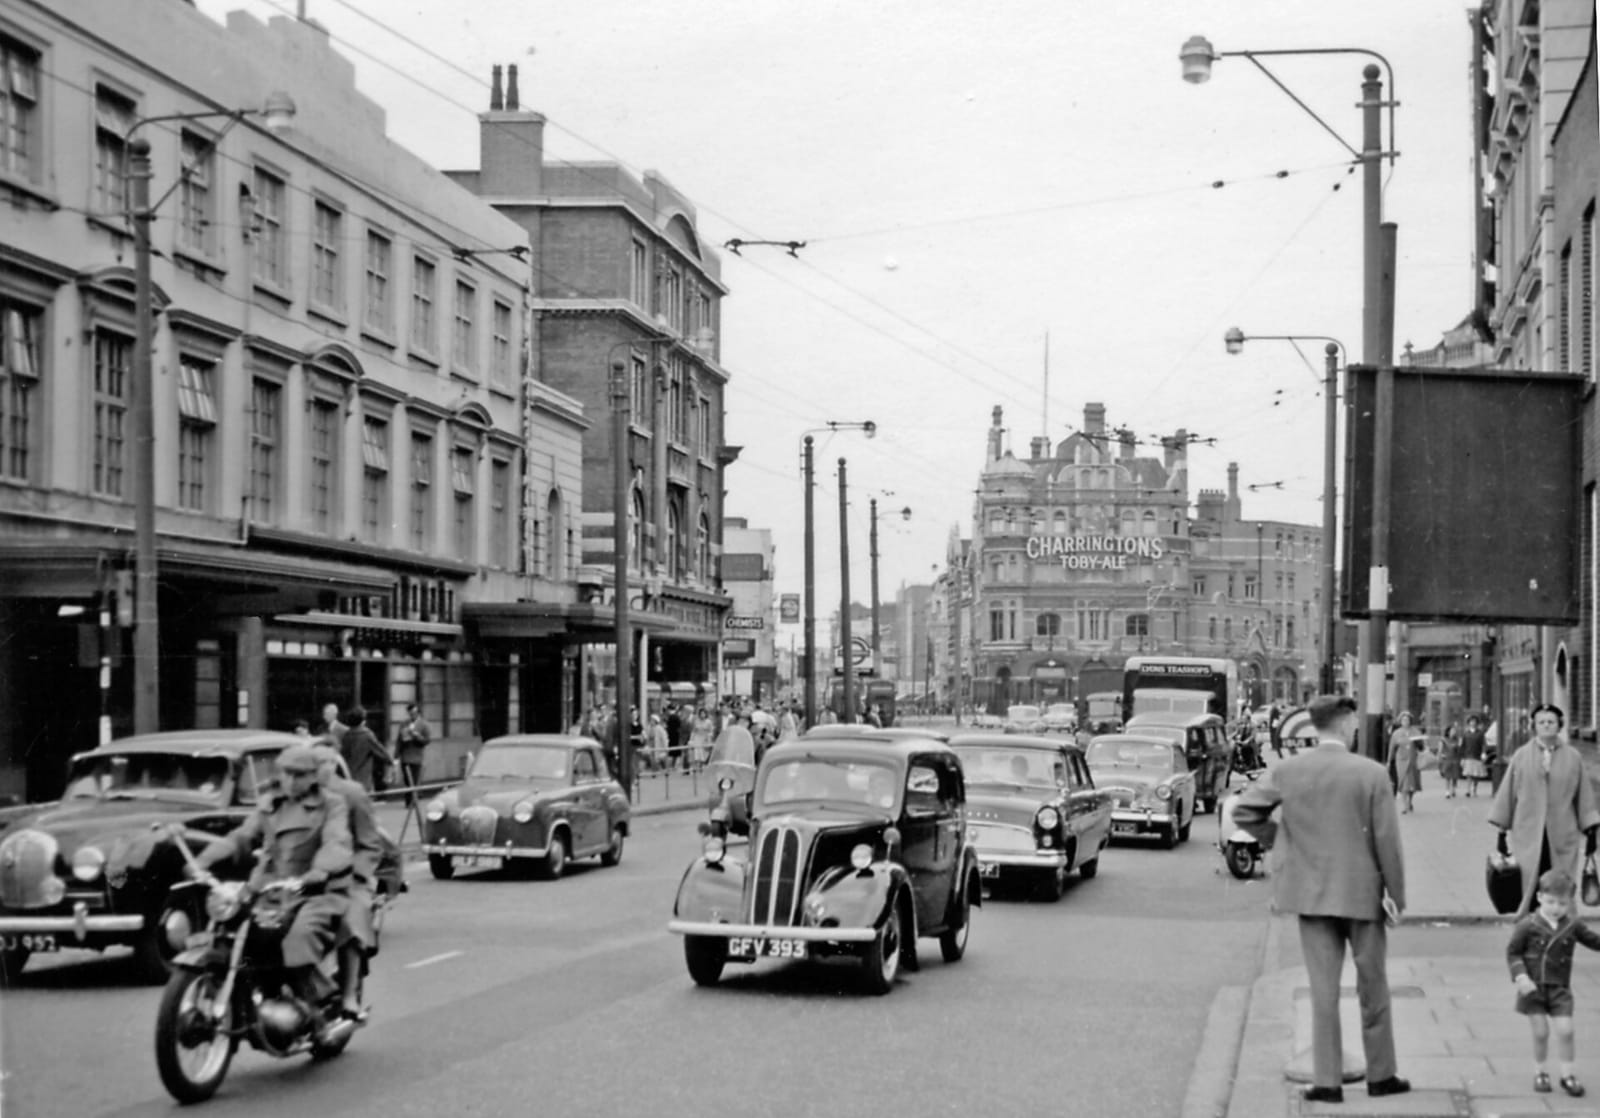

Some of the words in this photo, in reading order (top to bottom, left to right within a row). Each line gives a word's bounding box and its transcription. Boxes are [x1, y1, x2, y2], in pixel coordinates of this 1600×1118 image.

[1027, 536, 1163, 559] CHARRINGTONS
[1059, 555, 1127, 569] TOBY-ALE
[729, 937, 765, 955] GFV
[769, 938, 805, 957] 393
